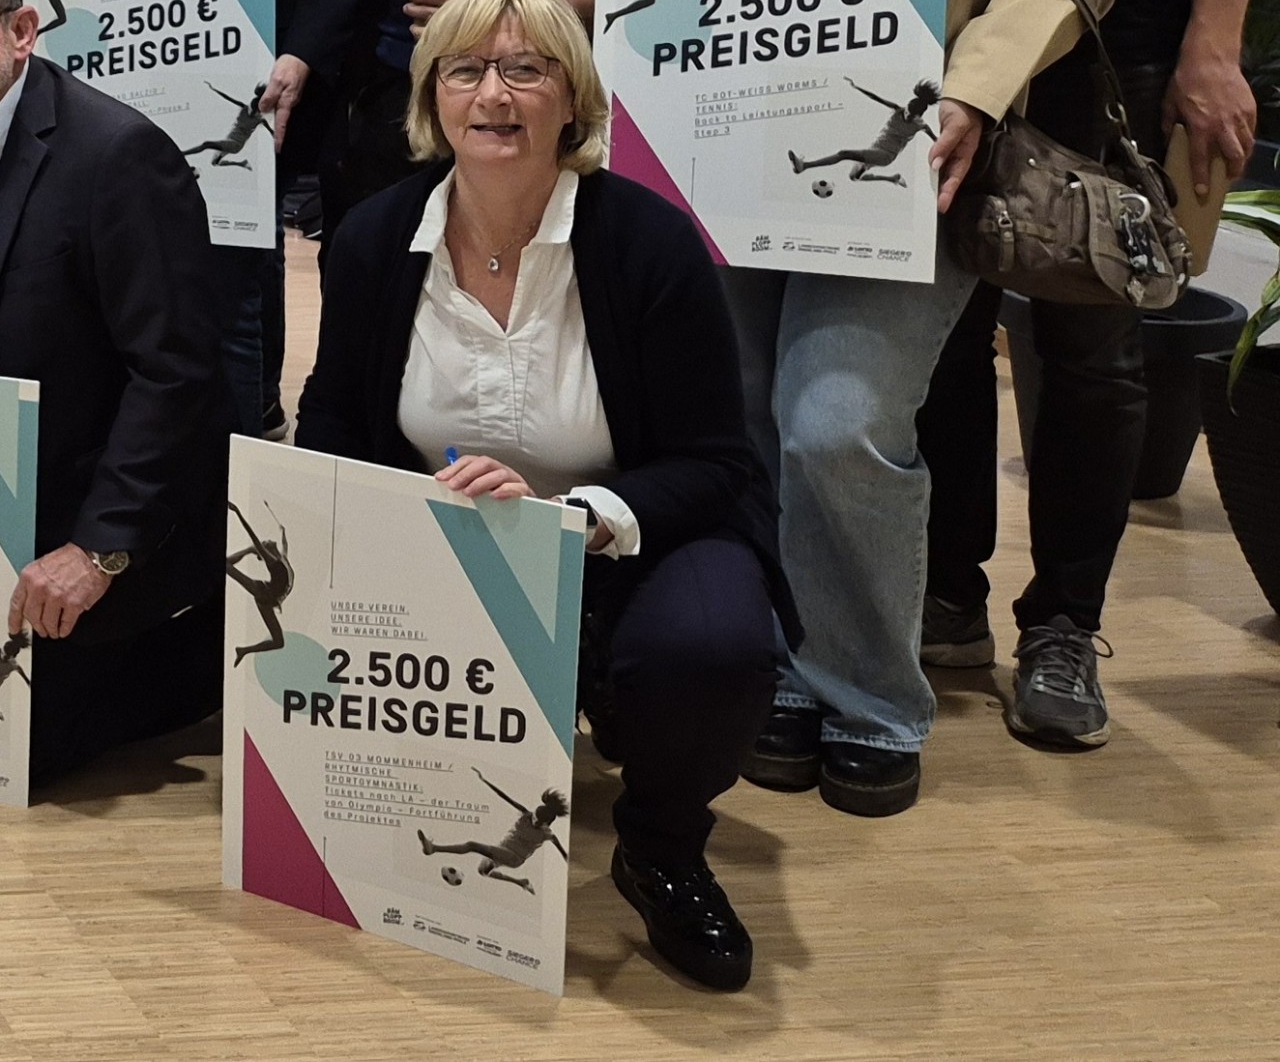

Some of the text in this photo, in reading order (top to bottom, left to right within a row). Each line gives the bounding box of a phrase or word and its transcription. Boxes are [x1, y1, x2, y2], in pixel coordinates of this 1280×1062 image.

[98, 0, 186, 42] 2.500
[652, 11, 899, 77] PREISGELD
[66, 25, 241, 83] PREISGELD
[713, 85, 770, 99] ROT-WEISS
[777, 80, 816, 91] WORMS
[330, 601, 363, 610] UNSER
[330, 613, 370, 623] UNSERE
[331, 626, 348, 634] WIR
[353, 627, 388, 636] WAREN
[326, 648, 495, 695] 2.500 €
[283, 689, 527, 744] PREISGELD
[325, 750, 342, 759] TSV
[367, 754, 441, 770] MOMMENHEIM
[325, 762, 391, 777] RHYTMISCHE
[348, 800, 391, 813] Olympia
[369, 791, 395, 800] nach
[401, 794, 414, 802] LA
[454, 800, 489, 811] Traum
[347, 812, 401, 826] Projektes
